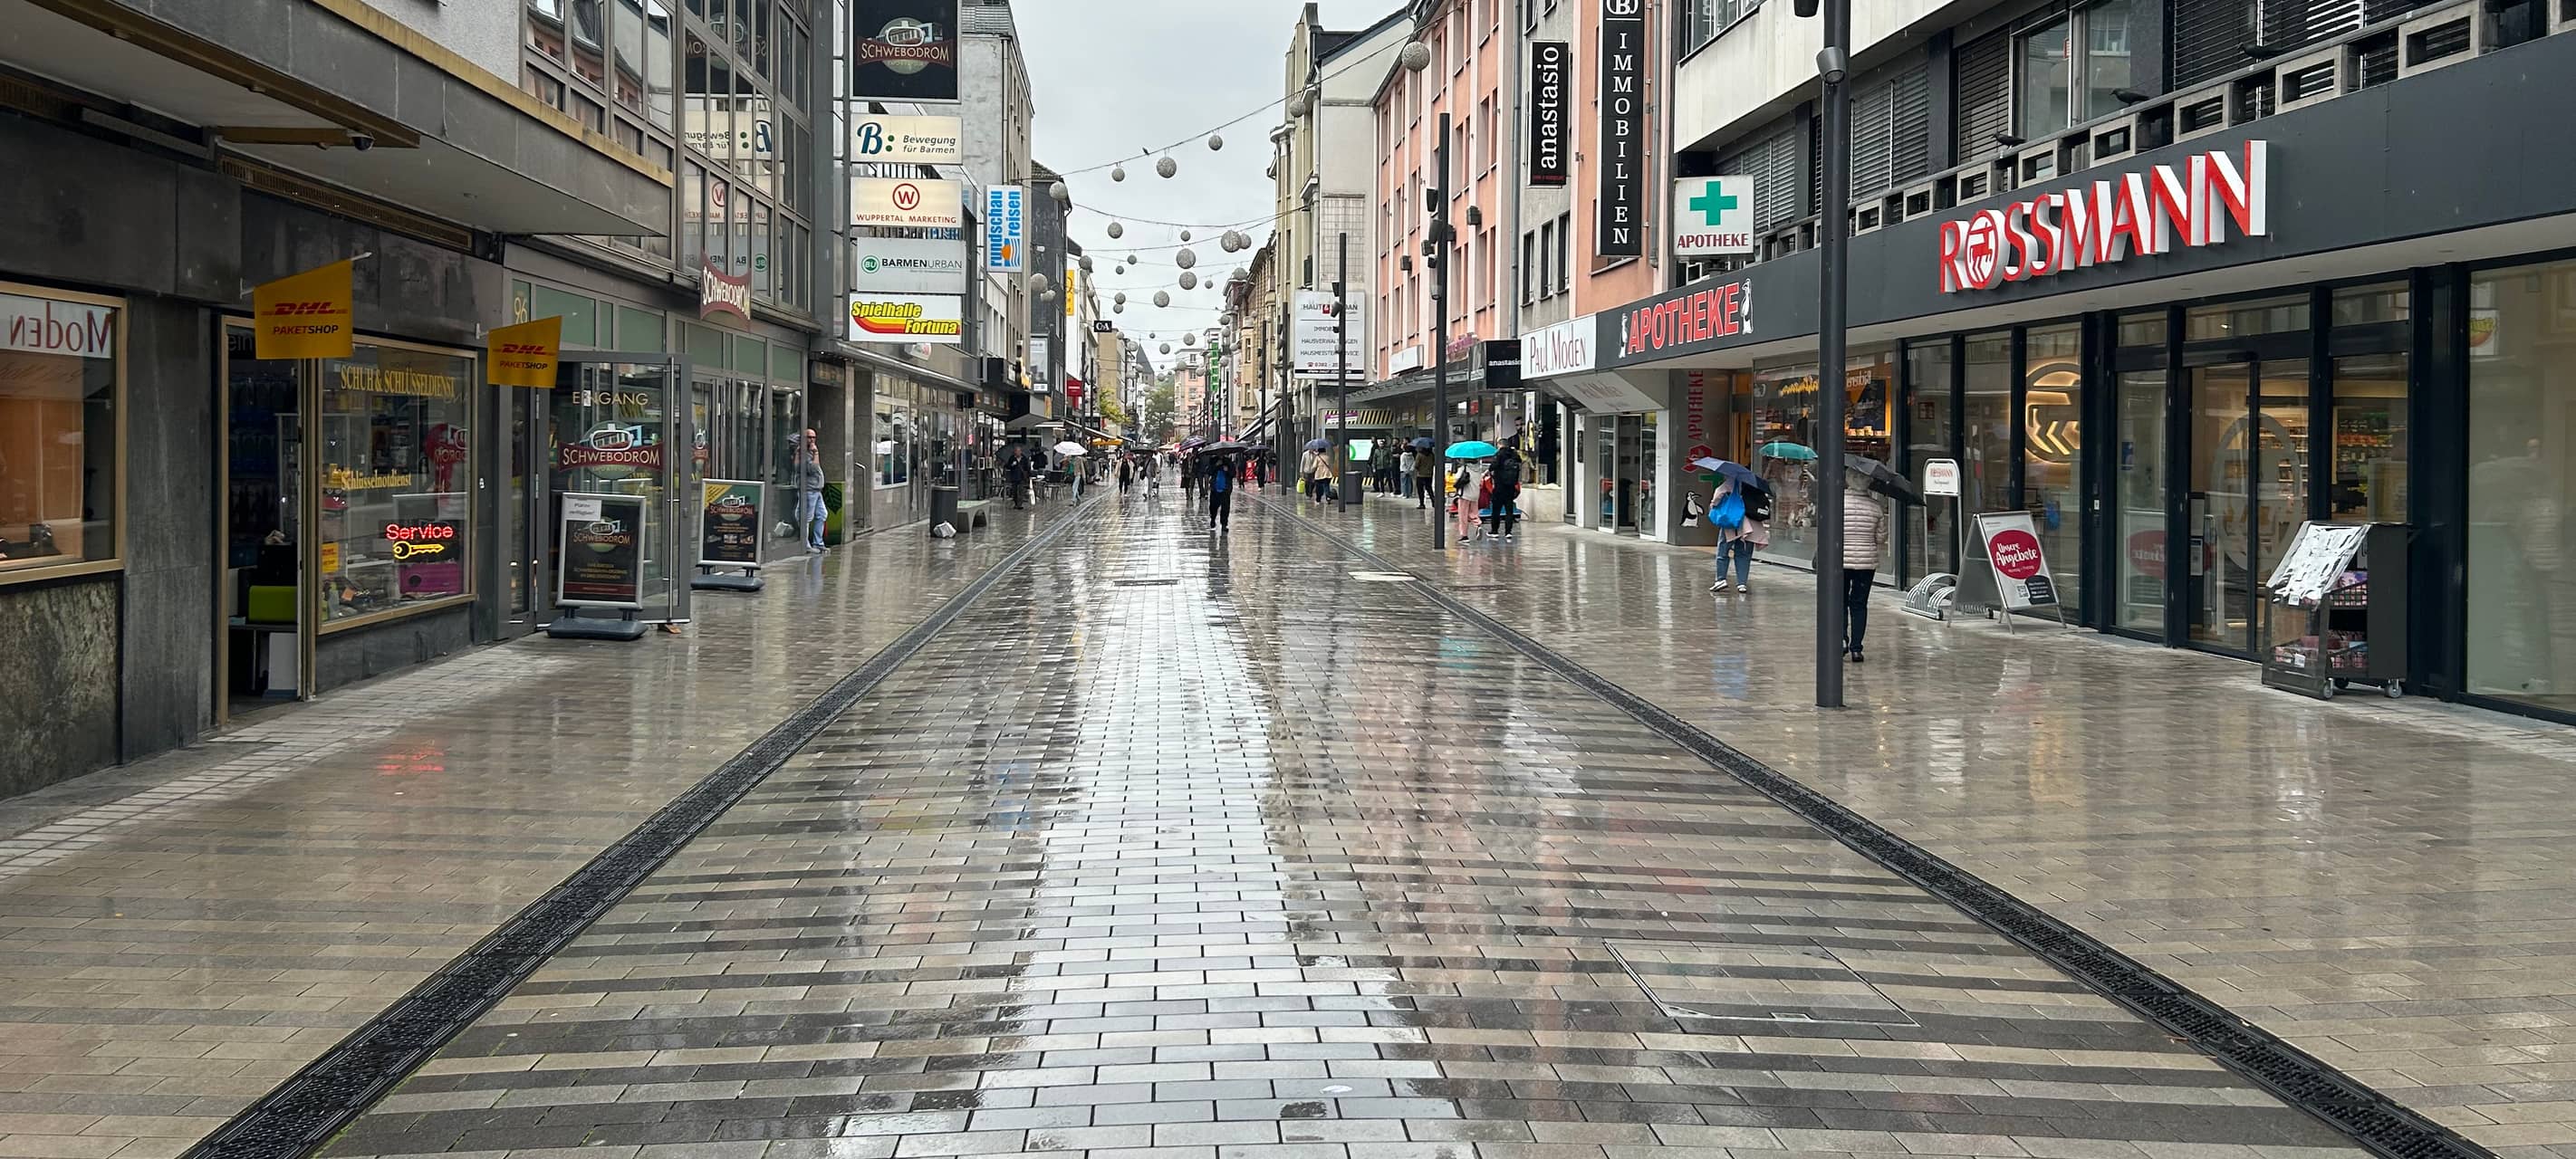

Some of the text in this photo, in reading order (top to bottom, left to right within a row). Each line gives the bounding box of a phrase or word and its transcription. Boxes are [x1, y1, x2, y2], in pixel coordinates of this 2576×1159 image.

[861, 43, 949, 62] SCHWEBODROM
[1536, 46, 1560, 169] anastasio
[902, 135, 956, 147] Bewegung
[1612, 33, 1633, 244] IMMOBILIEN
[903, 145, 956, 154] für Barmen
[856, 214, 957, 225] WUPPERTAL MARKETING
[1006, 190, 1021, 237] reisen
[1939, 139, 2267, 294] ROSSMANN
[988, 190, 1003, 267] rundschau
[1677, 233, 1750, 249] APOTHEKE
[881, 259, 963, 270] BARMENURBAN
[702, 265, 751, 321] SCHWEBODROM
[274, 302, 336, 316] DHL
[514, 296, 528, 324] 96
[851, 300, 923, 320] Spielhalle
[905, 319, 958, 335] Fortuna
[1095, 321, 1110, 331] C&A
[1628, 282, 1740, 355] APOTHEKE
[274, 324, 339, 335] PAKETSHOP
[501, 343, 548, 356] DHL
[499, 360, 548, 370] PAKETSHOP
[341, 365, 457, 398] SCHUH & SCHLÜSSELDIENST
[572, 391, 649, 406] ENGANG
[1687, 369, 1704, 440] APOTHEKE
[562, 448, 660, 466] SCHWEBODROM
[341, 468, 412, 491] Schlüsselnotdienst
[385, 523, 455, 540] Service
[572, 532, 630, 544] SCHWEBODROM
[1996, 542, 2021, 553] Unsere
[1995, 548, 2039, 568] Angebote
